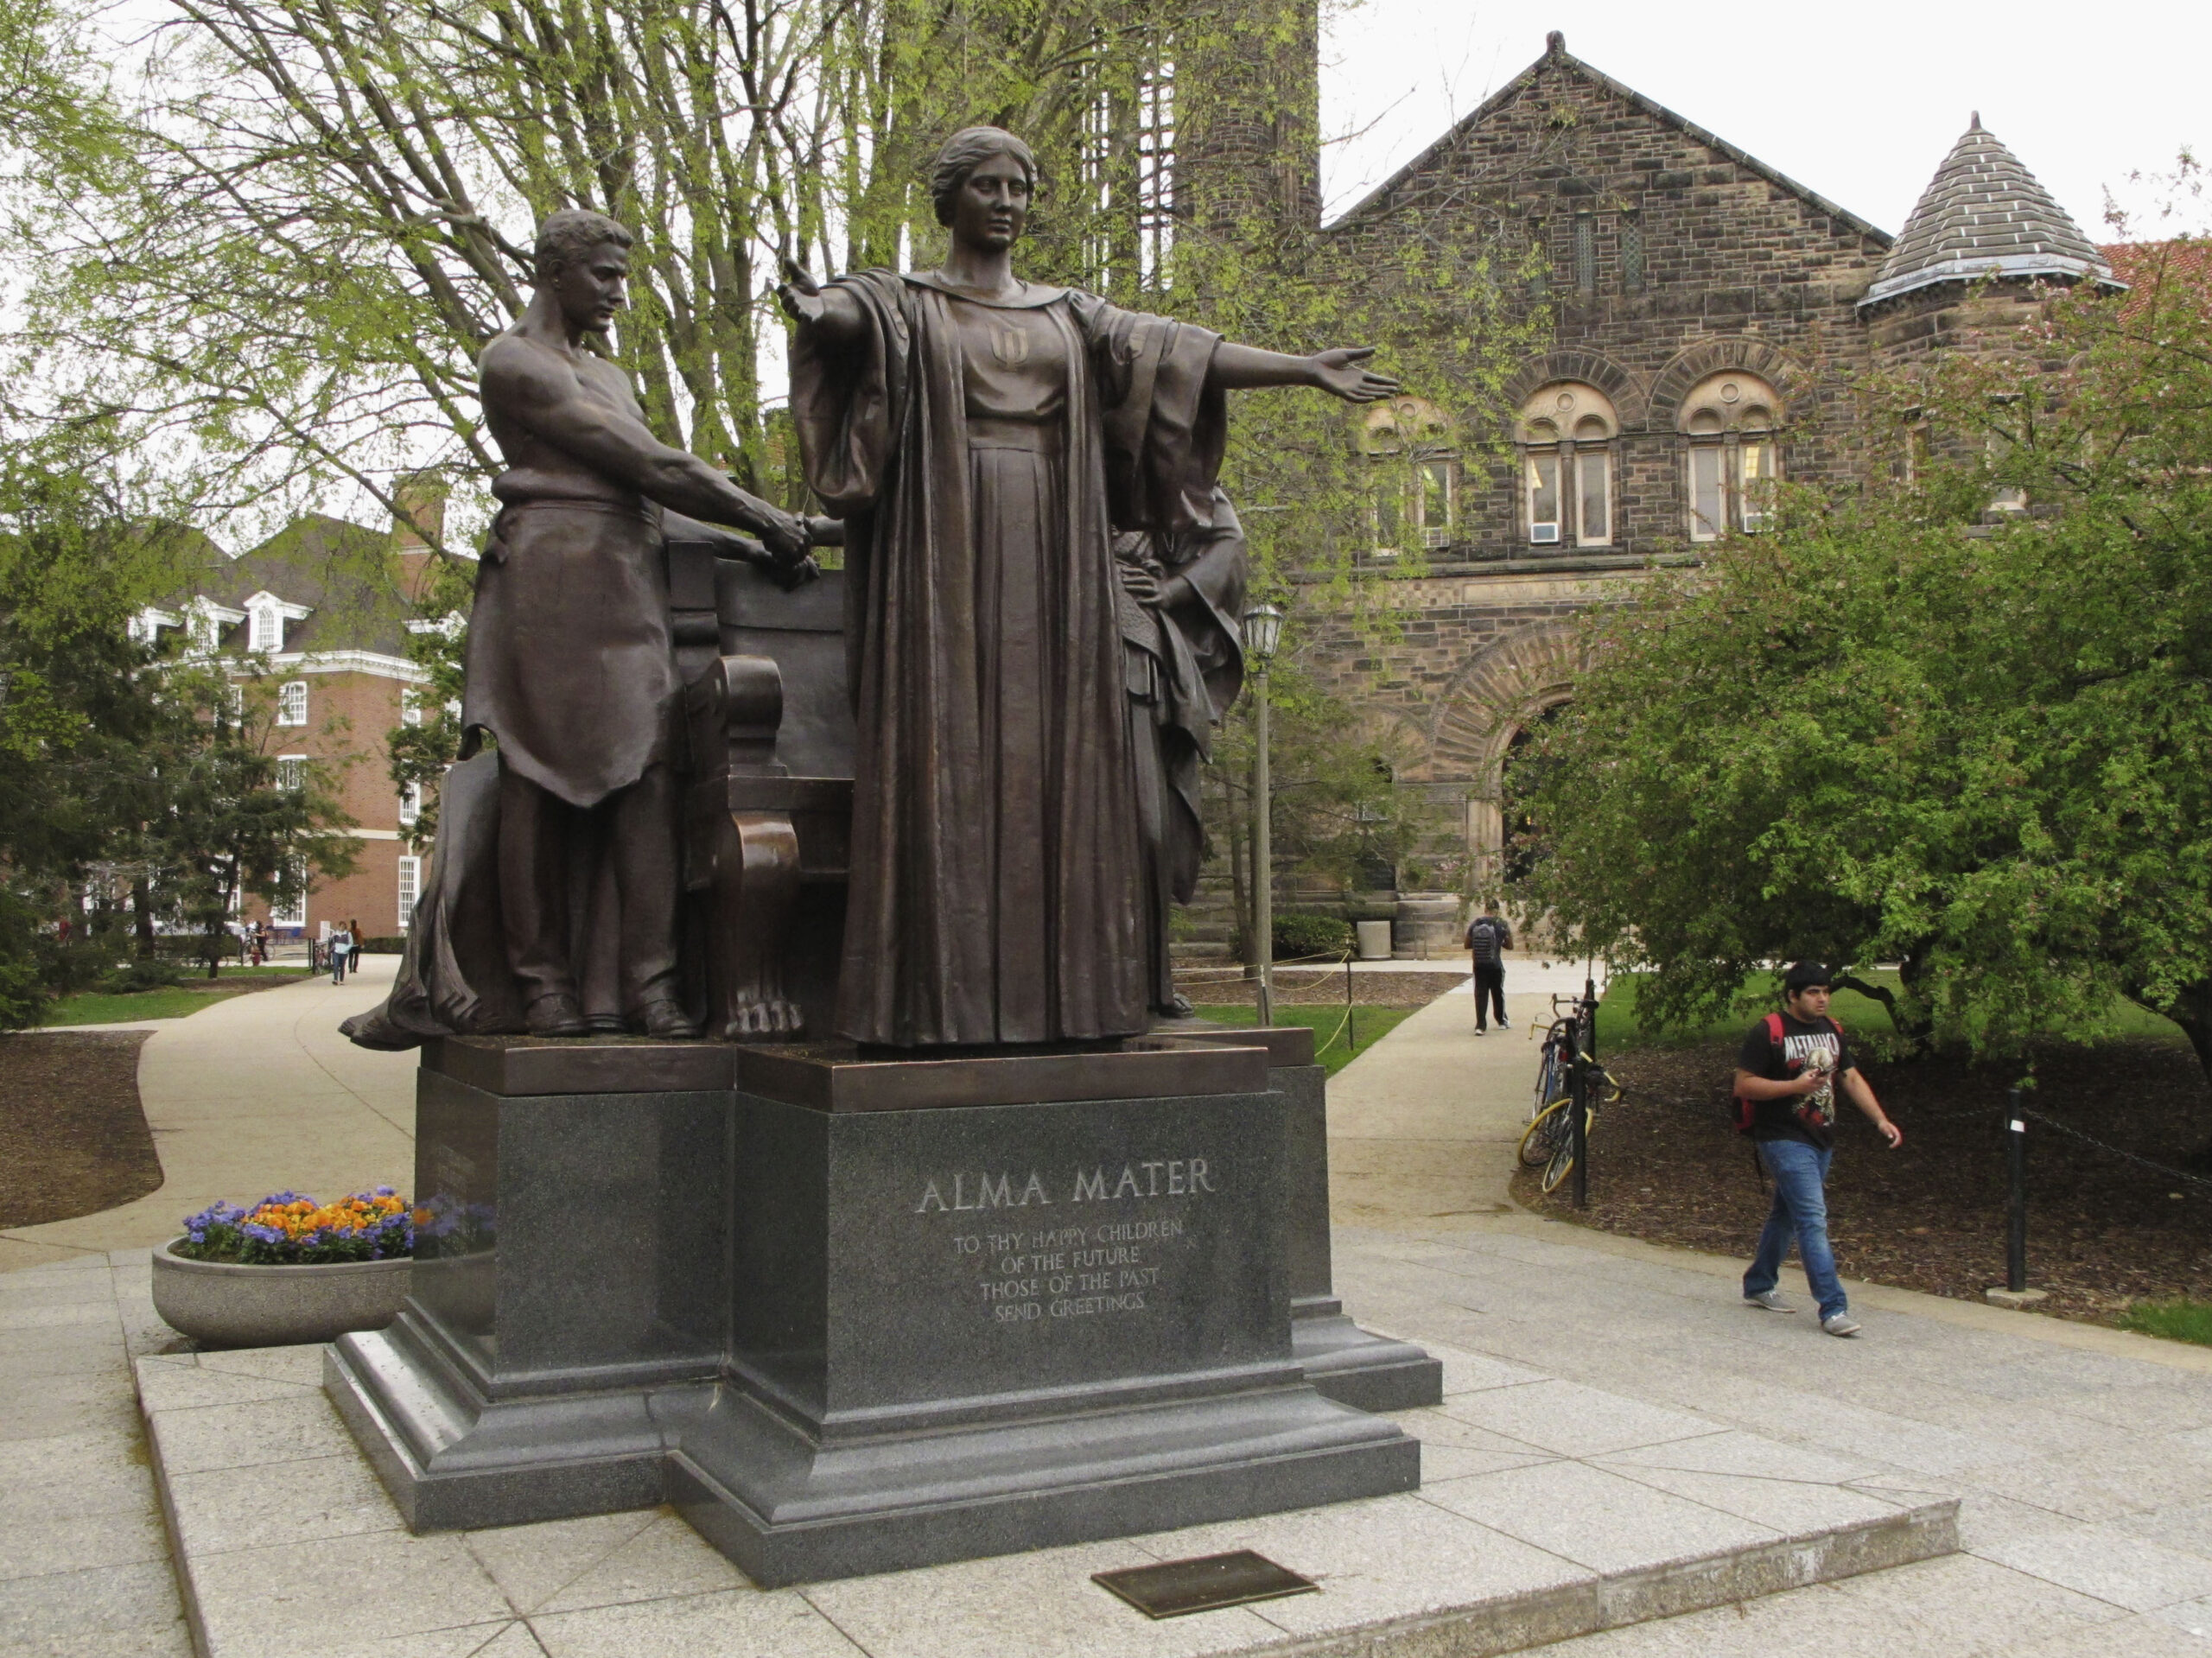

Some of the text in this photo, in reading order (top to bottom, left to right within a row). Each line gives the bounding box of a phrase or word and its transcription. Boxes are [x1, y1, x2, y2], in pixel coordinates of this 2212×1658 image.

[914, 1159, 1216, 1213] ALMA MATER
[954, 1219, 1183, 1254] TO THY HAPPY CHILDREN
[1001, 1246, 1141, 1274] OF THE FUTURE
[980, 1267, 1159, 1300] THOSE OF THE PAST
[995, 1292, 1145, 1323] SEND GREETINGS
